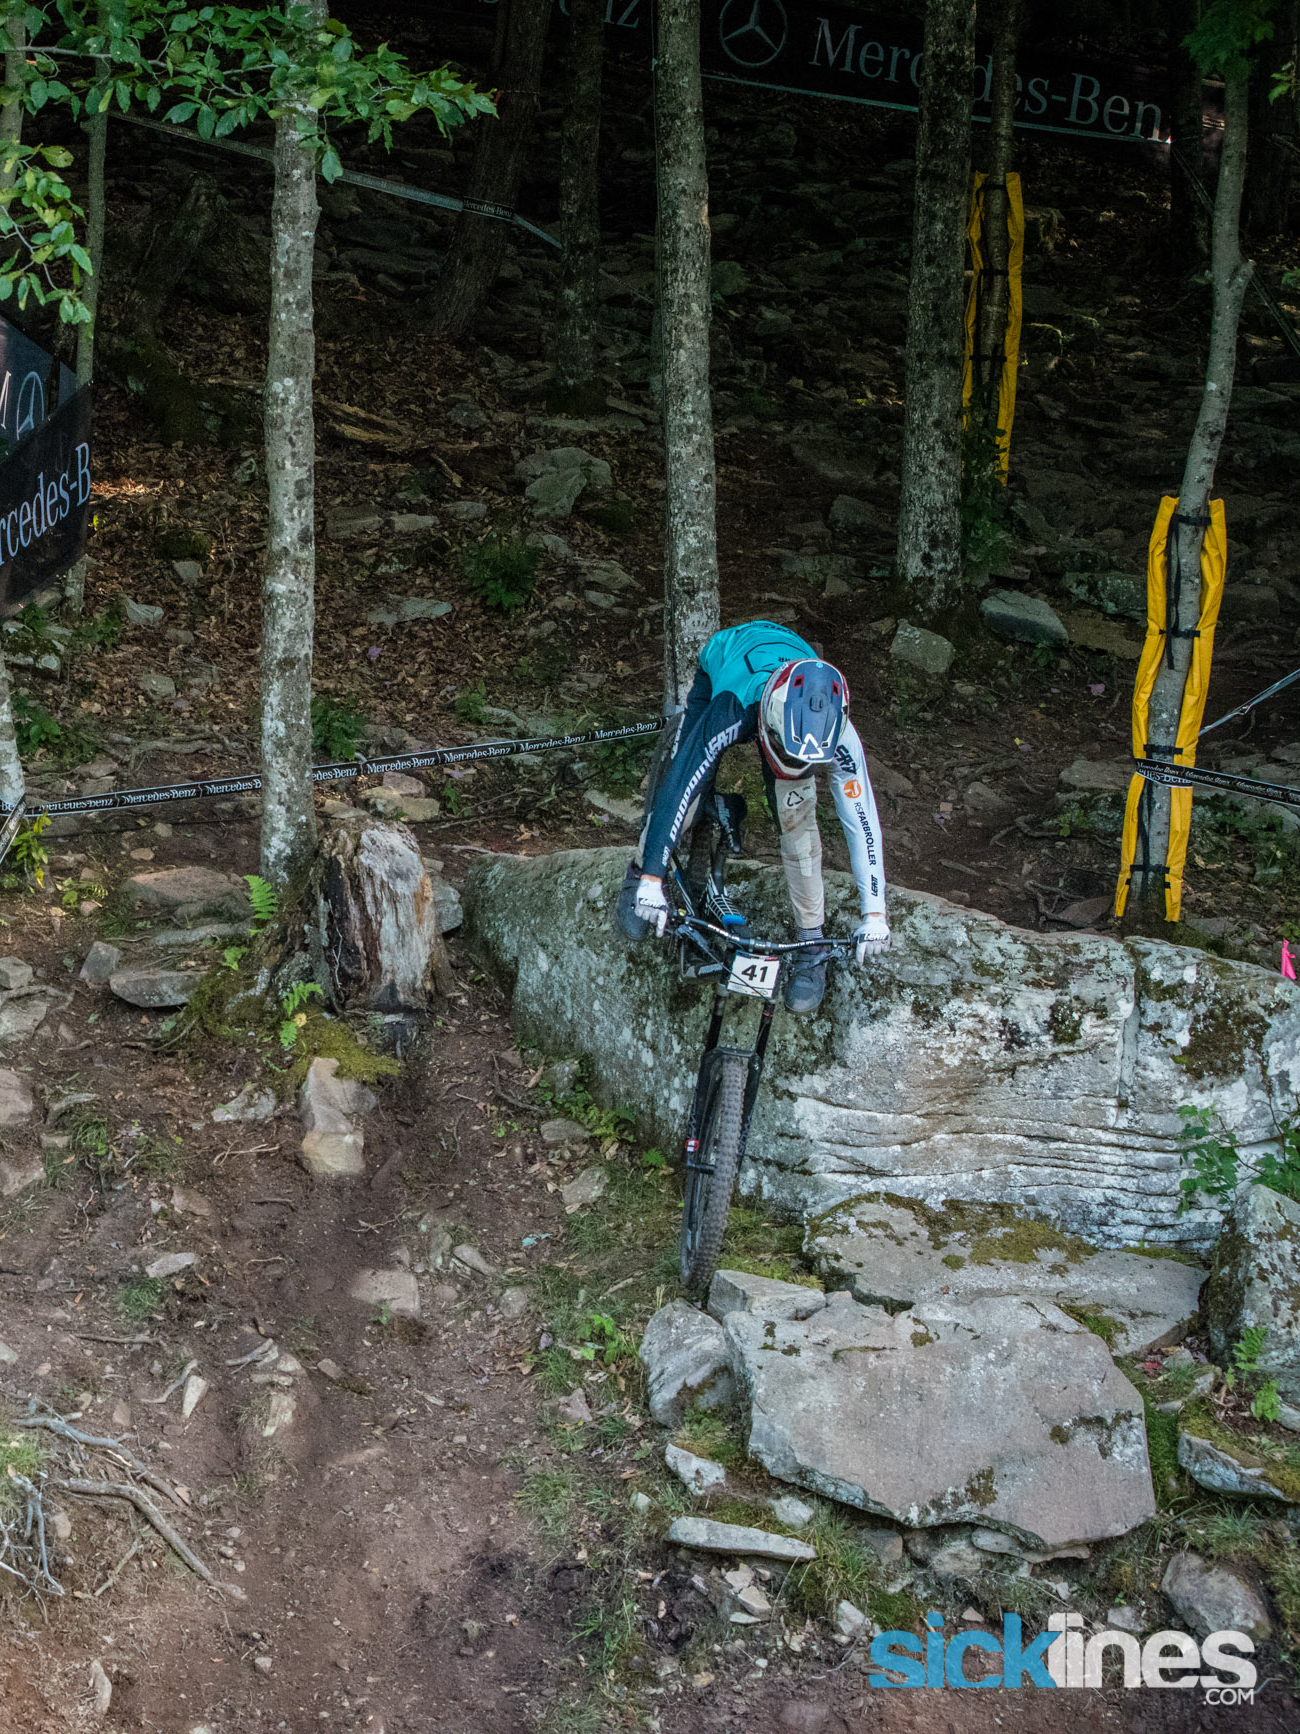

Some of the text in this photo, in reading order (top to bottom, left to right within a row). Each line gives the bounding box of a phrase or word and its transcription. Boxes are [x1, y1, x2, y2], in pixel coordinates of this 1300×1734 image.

[121, 786, 198, 804] Mercedes-Benz
[204, 777, 263, 795] Mercedes-B
[366, 756, 436, 774] Mercedes-Benz
[443, 745, 512, 764] Mercedes-Benz
[741, 964, 769, 983] 41
